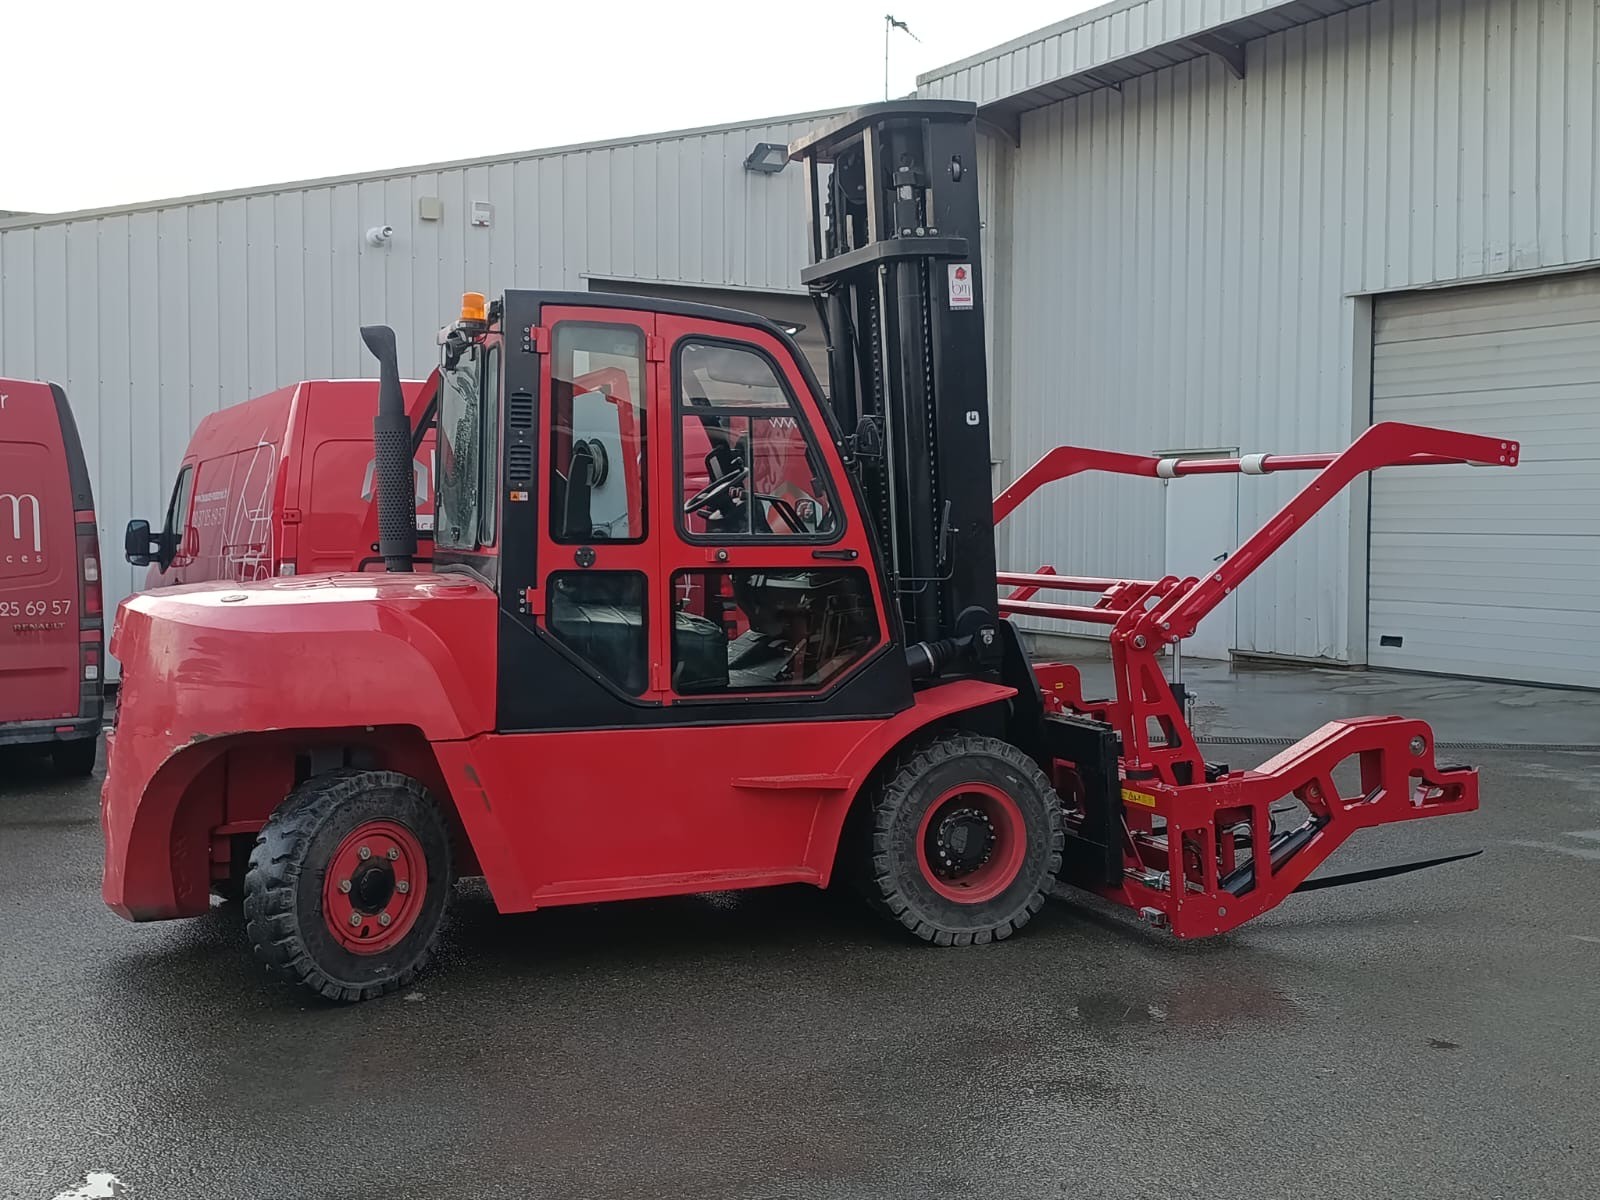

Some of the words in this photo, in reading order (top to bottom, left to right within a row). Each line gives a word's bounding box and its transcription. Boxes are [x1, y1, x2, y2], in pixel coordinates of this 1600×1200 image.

[0, 601, 20, 617] 25
[25, 600, 47, 616] 69
[51, 600, 71, 615] 57
[13, 622, 66, 631] RENAULT
